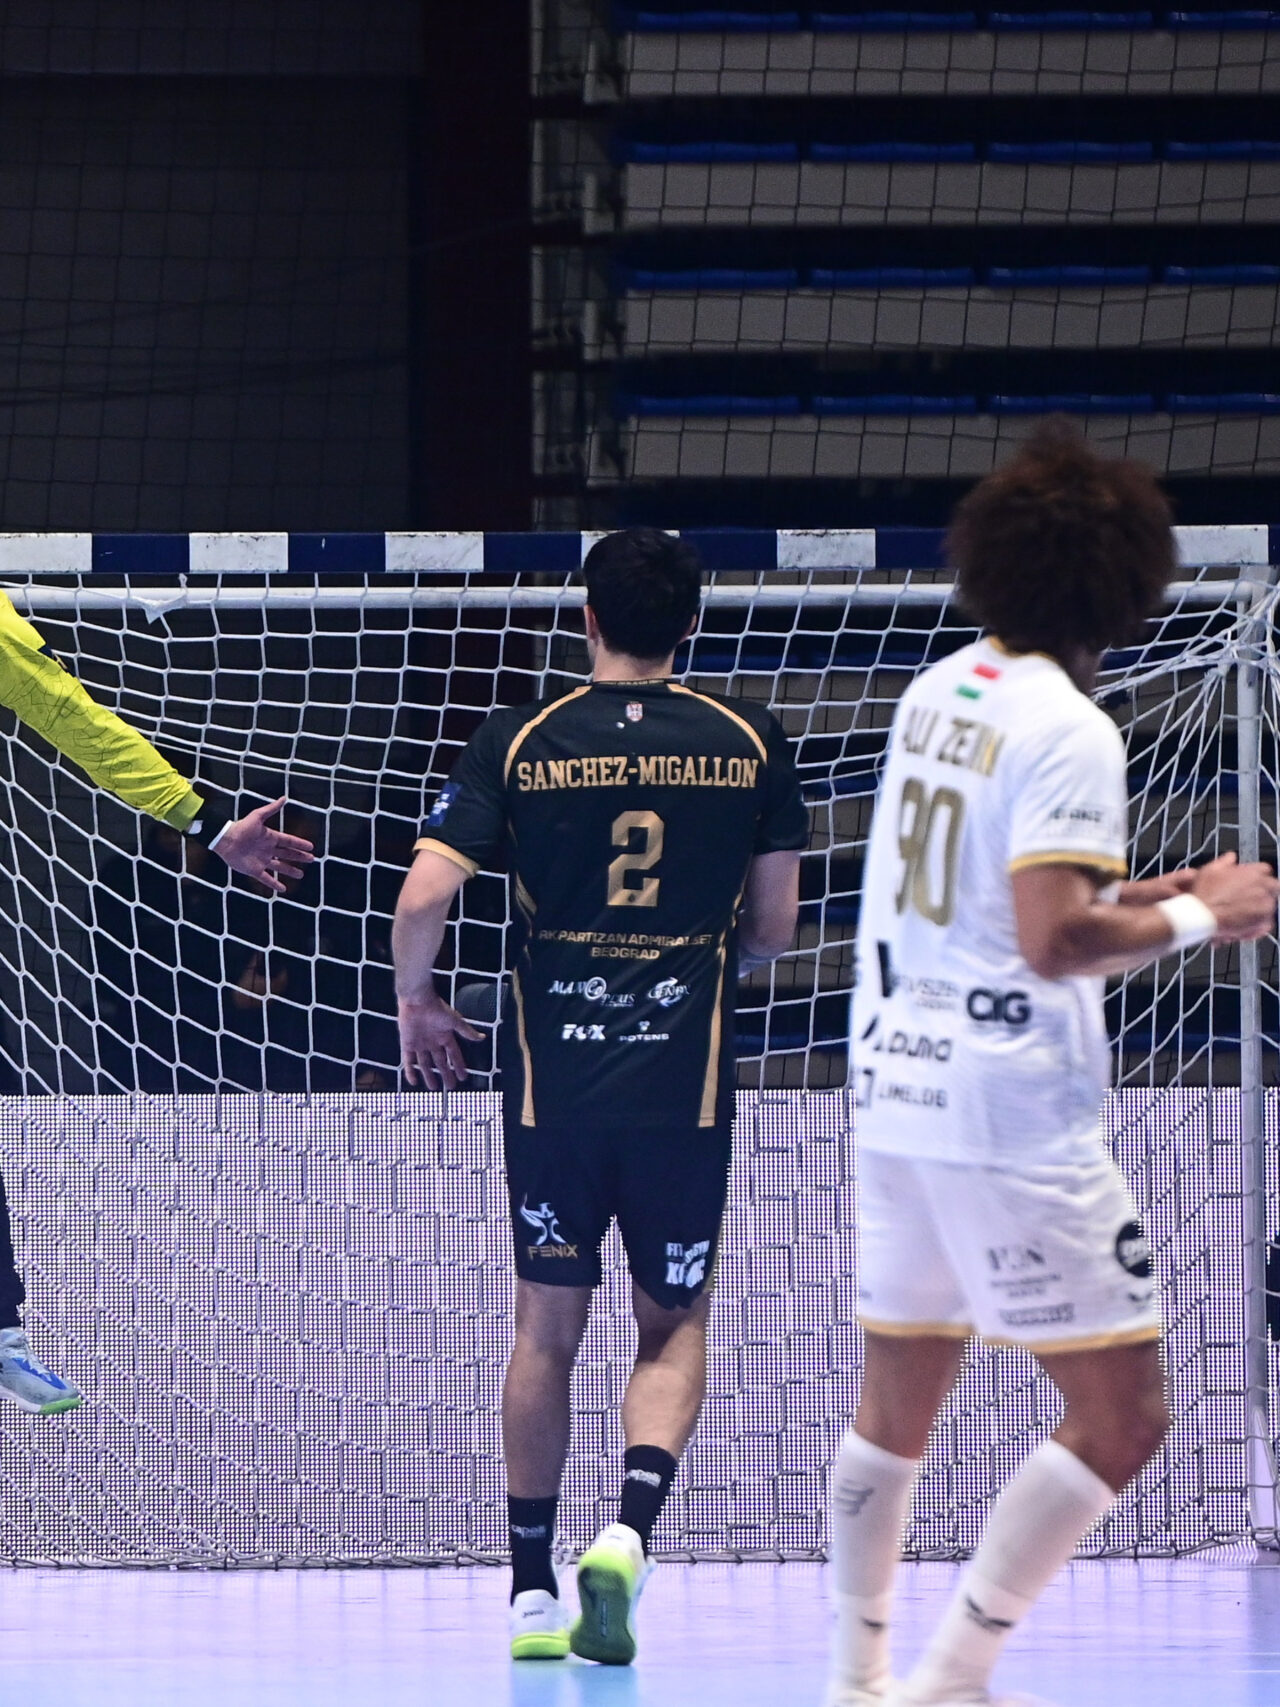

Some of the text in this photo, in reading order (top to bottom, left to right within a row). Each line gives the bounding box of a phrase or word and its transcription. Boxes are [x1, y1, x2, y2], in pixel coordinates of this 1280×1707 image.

[517, 755, 760, 792] SANCHEZ-MIGALLON
[607, 810, 665, 908] 2
[894, 776, 967, 927] 90
[558, 930, 626, 944] PARTIZAN
[591, 946, 661, 960] BEOGRAD
[966, 987, 1033, 1026] CIG
[527, 1244, 578, 1261] FENIX
